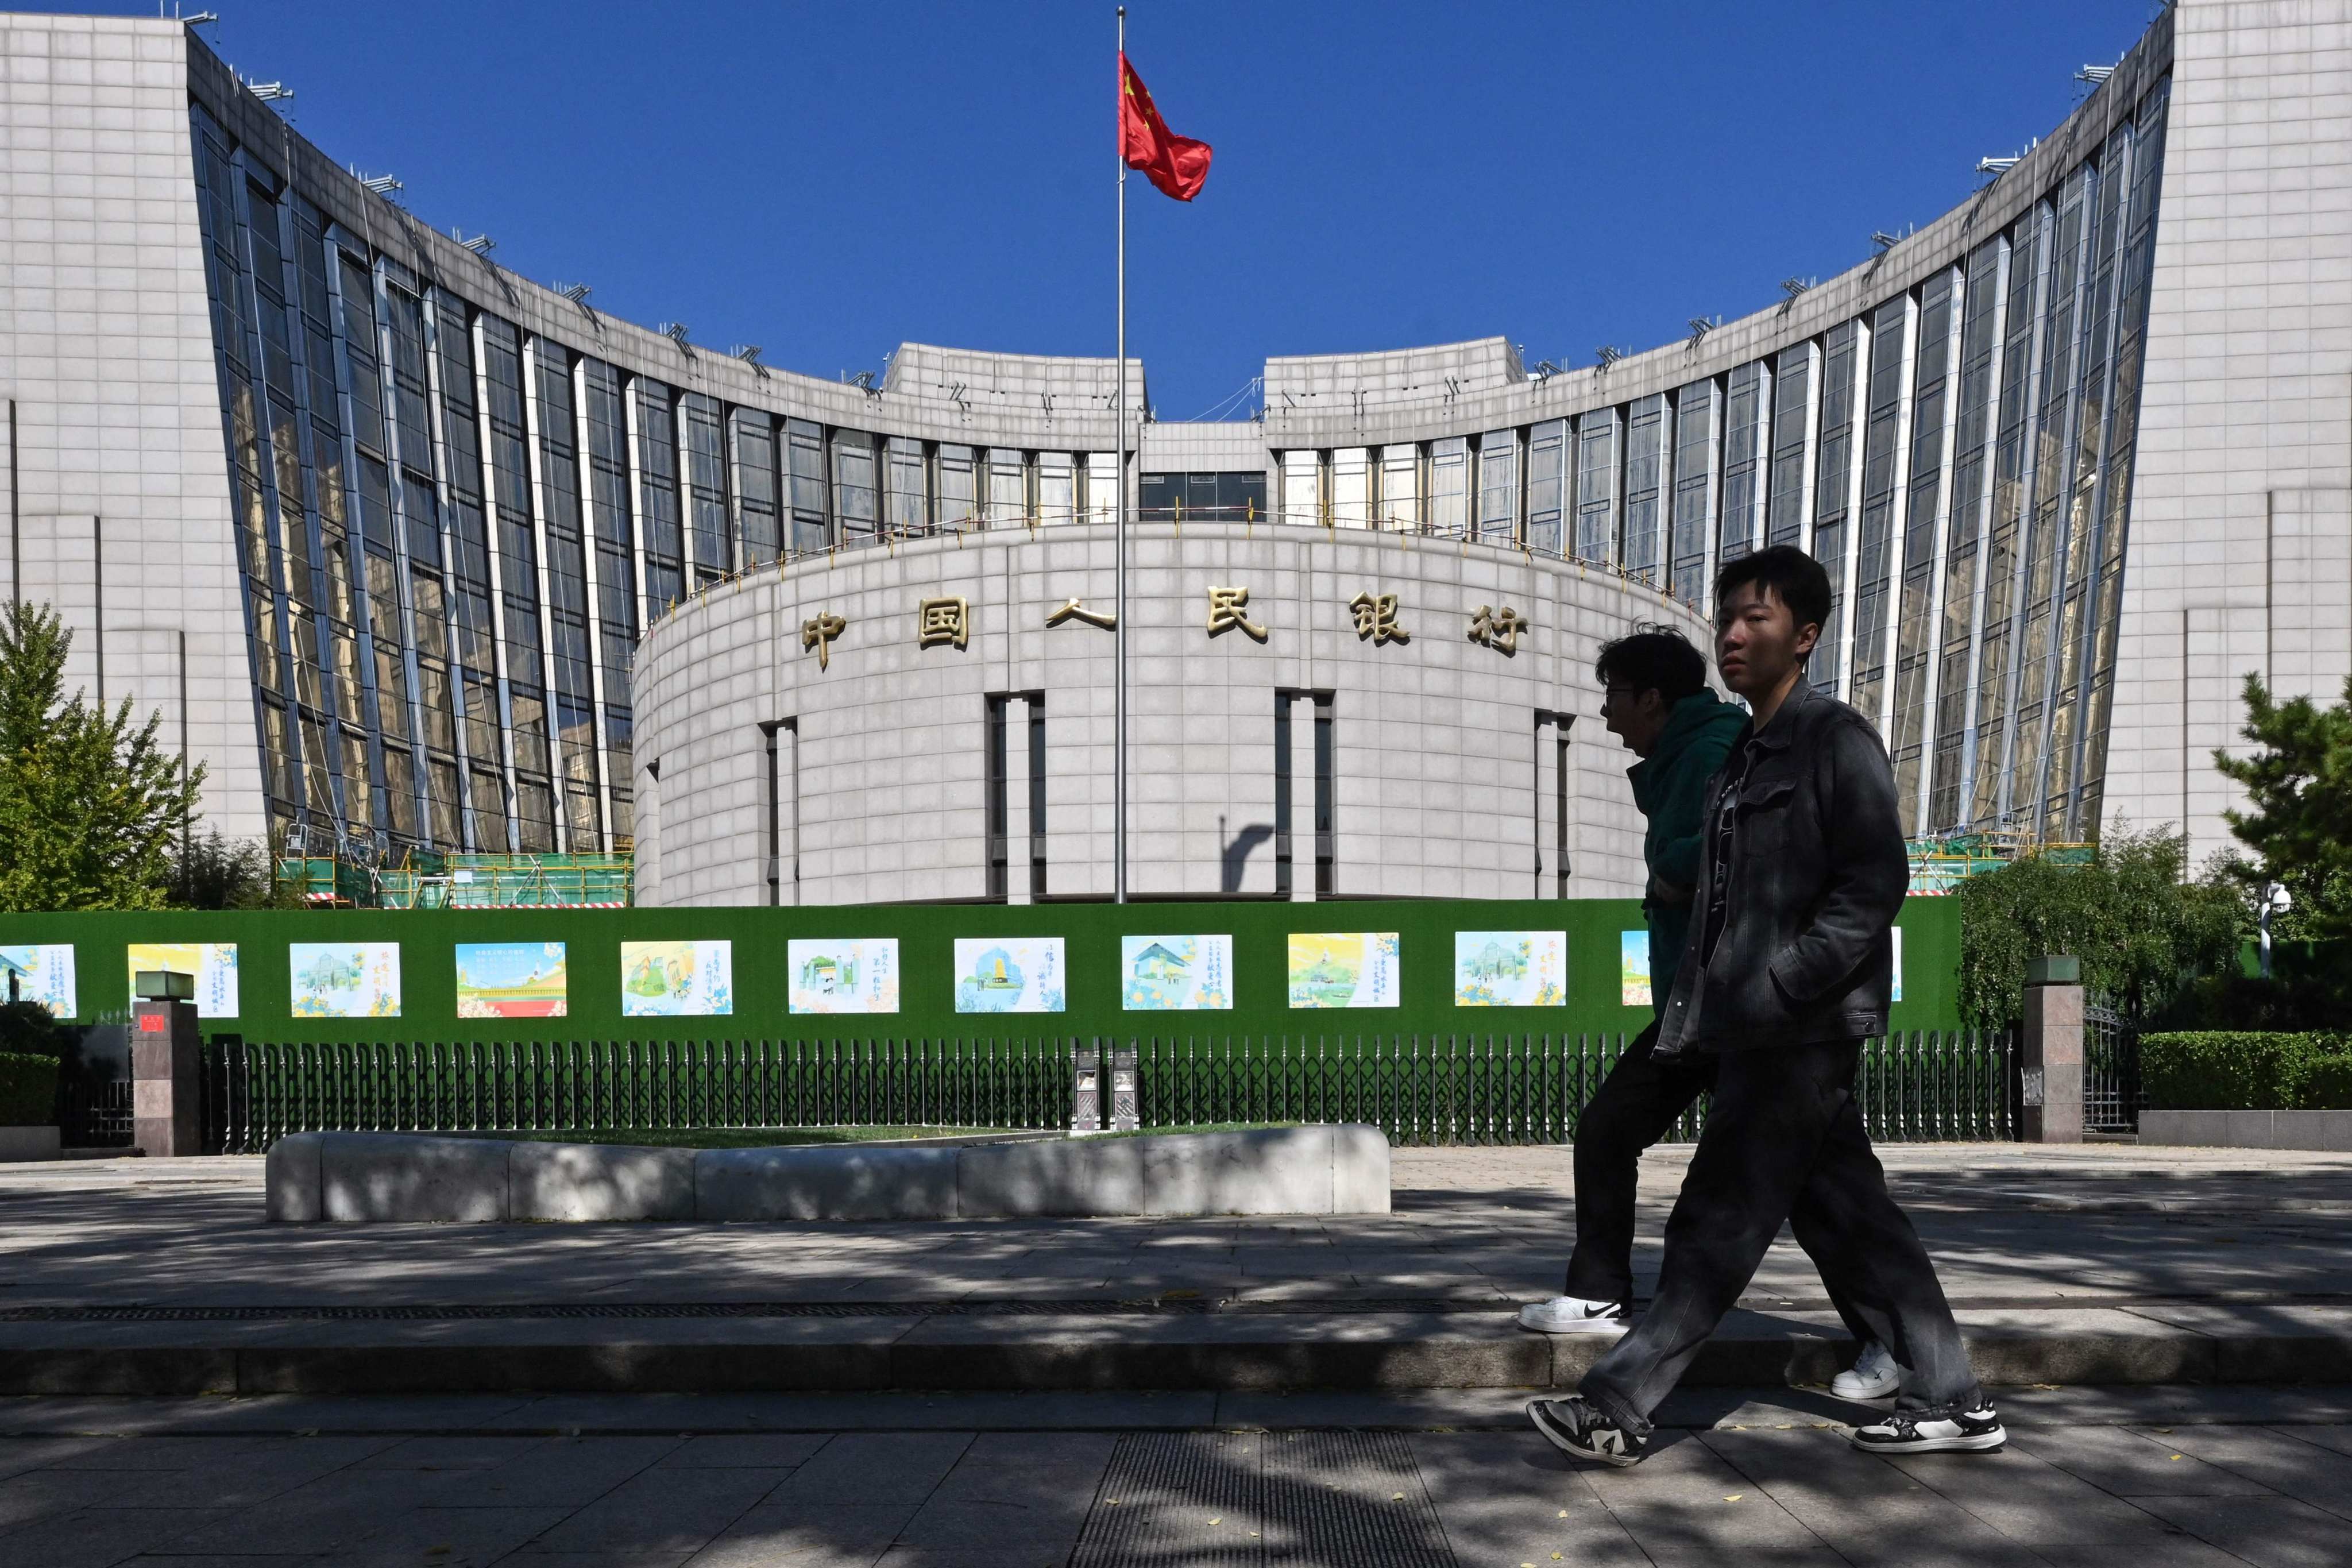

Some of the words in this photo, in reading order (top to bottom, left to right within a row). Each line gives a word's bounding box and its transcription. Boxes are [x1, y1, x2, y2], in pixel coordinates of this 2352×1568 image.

[802, 585, 1528, 667] 中国人民银行
